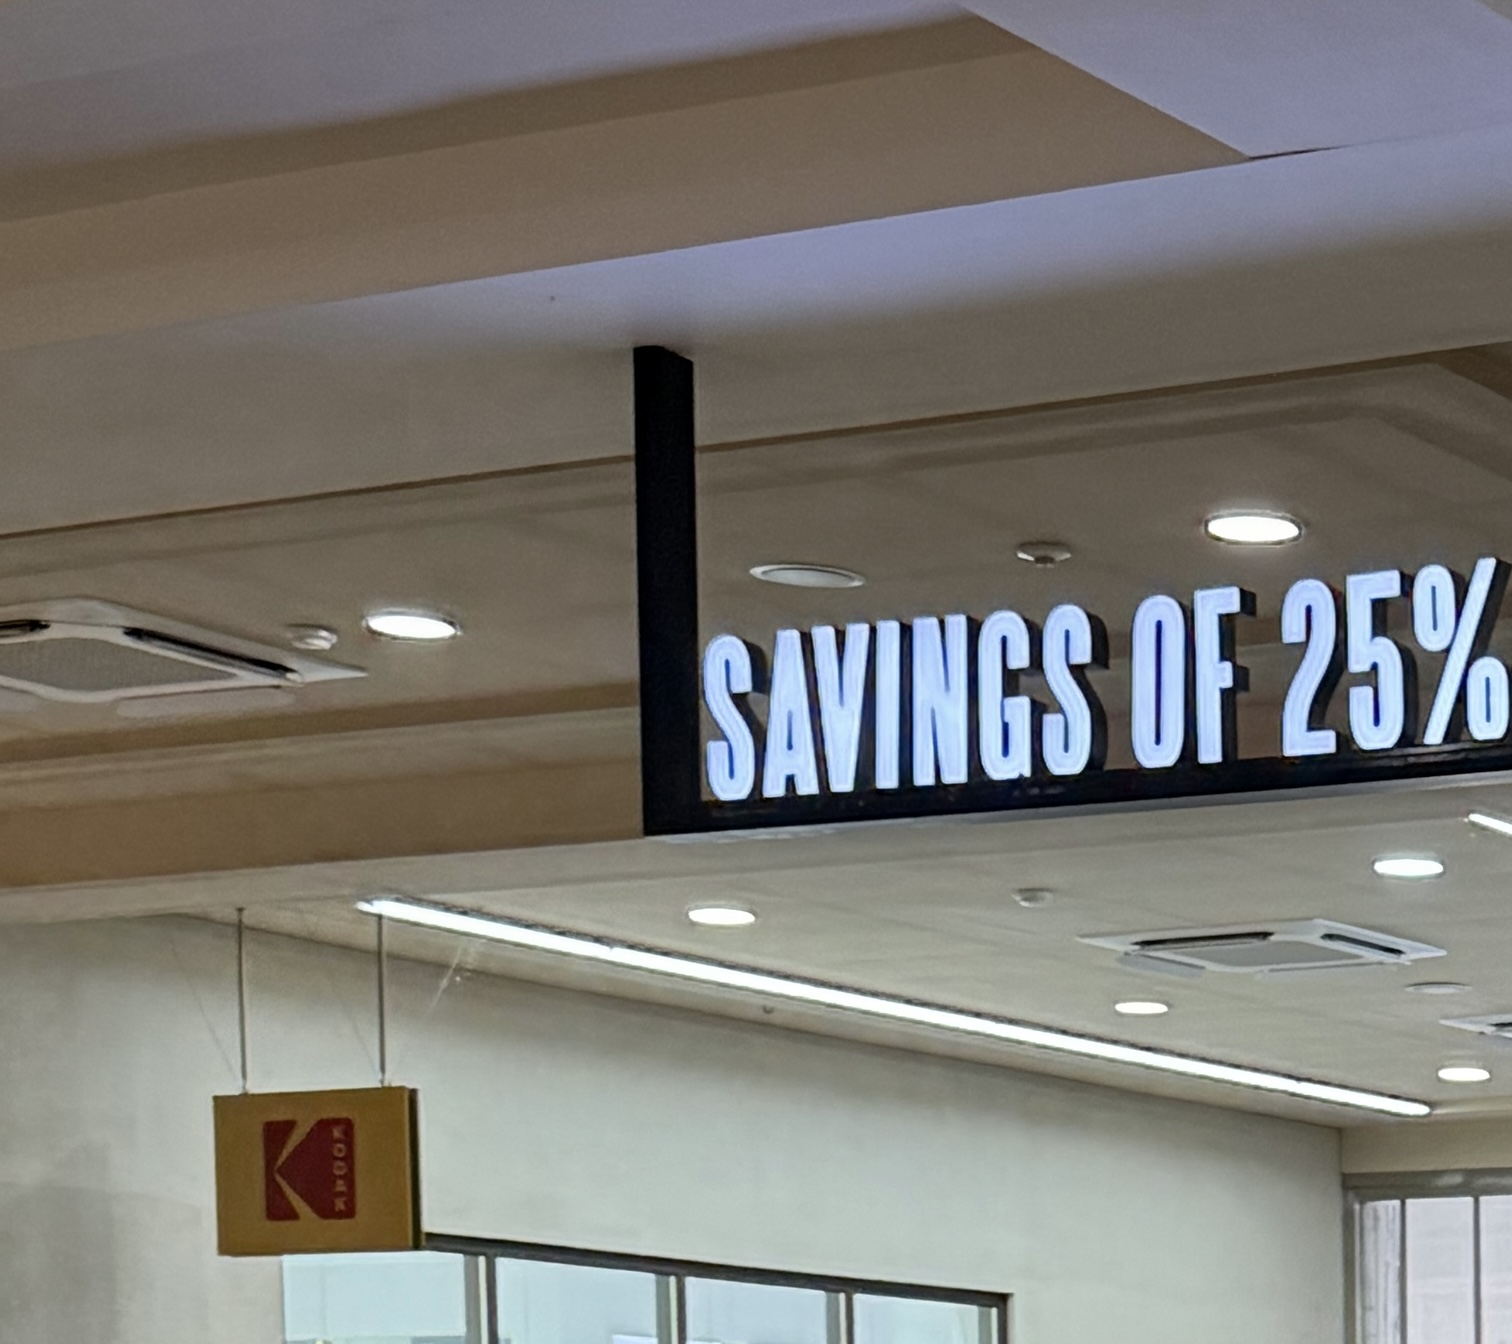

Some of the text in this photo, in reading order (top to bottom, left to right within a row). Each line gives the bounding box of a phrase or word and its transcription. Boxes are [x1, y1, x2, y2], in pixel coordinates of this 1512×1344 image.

[702, 604, 1093, 802] SAVINGS
[1131, 586, 1243, 769] OF
[1281, 557, 1510, 757] 25%
